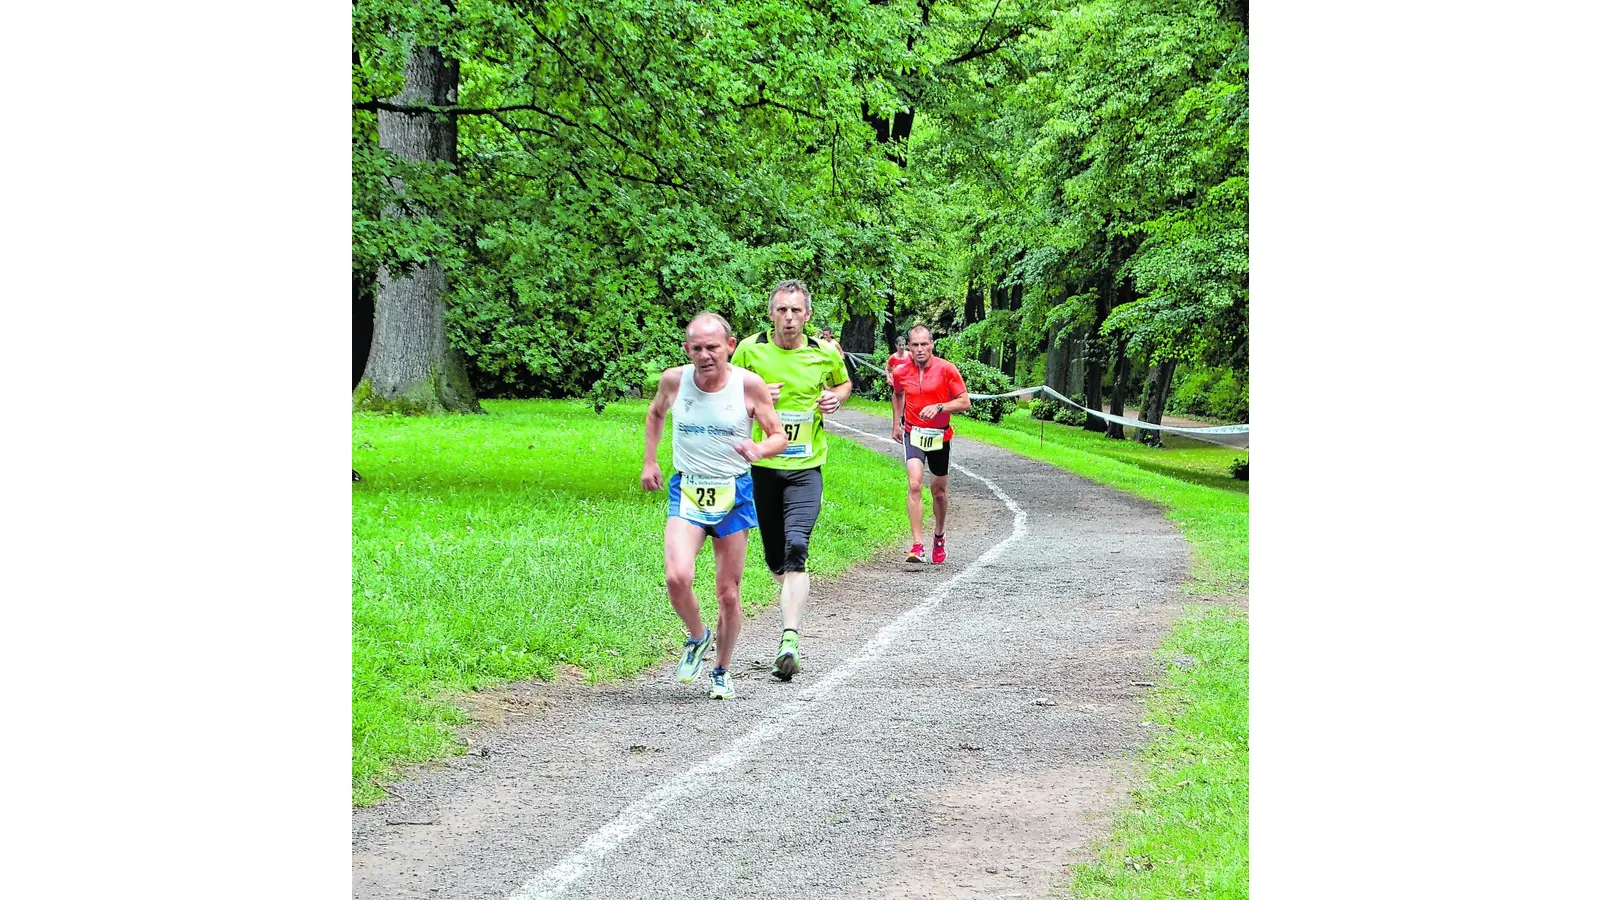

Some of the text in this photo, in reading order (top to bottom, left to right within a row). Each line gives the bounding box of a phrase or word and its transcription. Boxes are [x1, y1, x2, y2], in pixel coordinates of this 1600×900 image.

[678, 421, 705, 435] Equipe
[781, 423, 800, 441] 67
[920, 435, 934, 448] 110
[696, 487, 716, 507] 23
